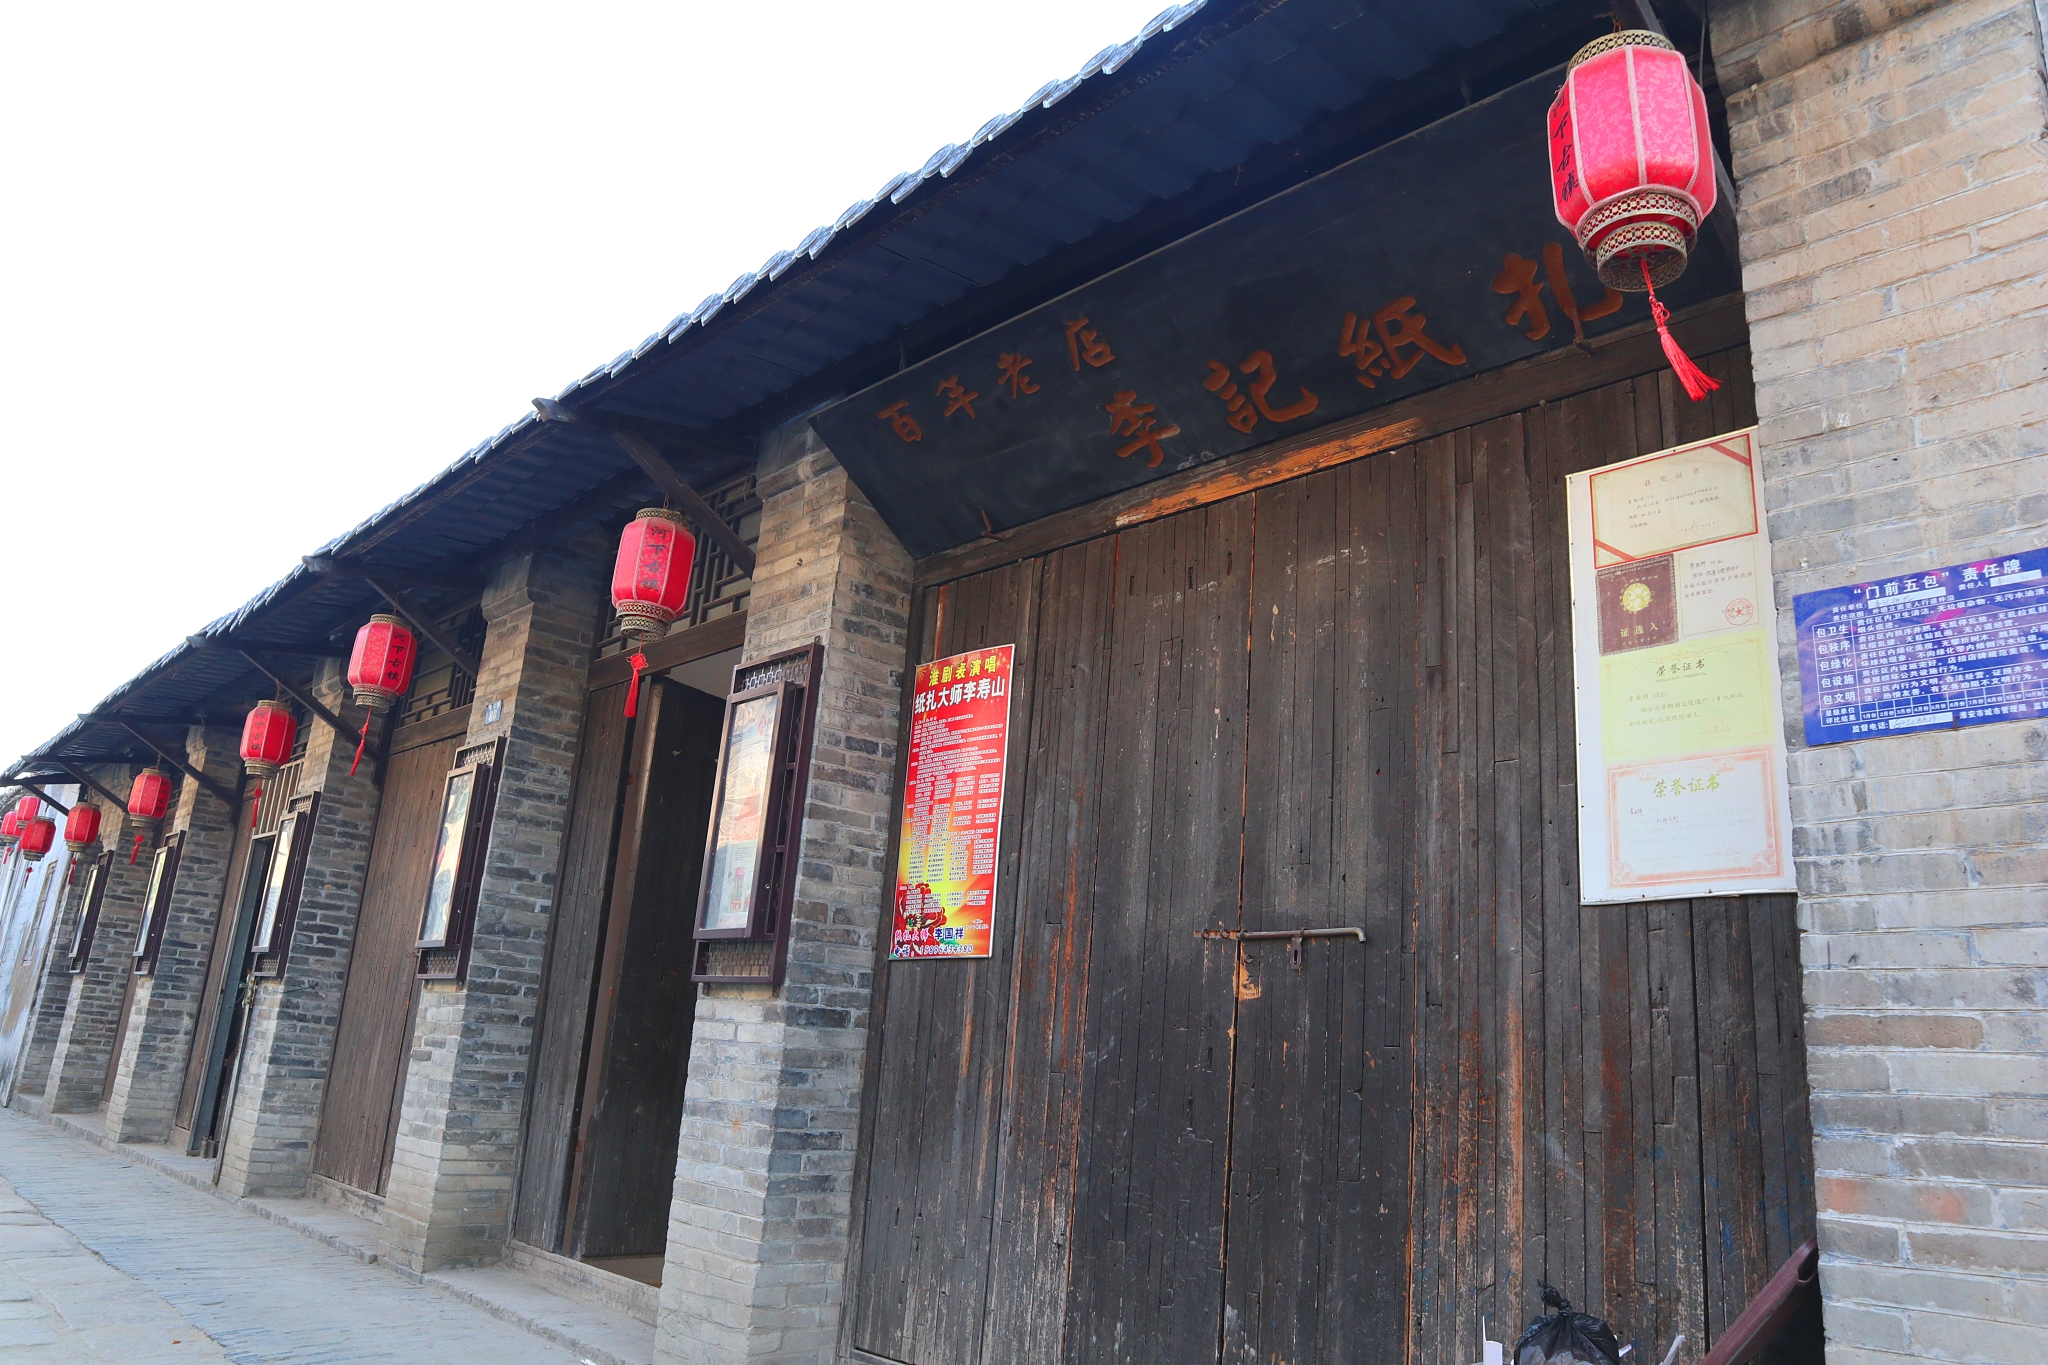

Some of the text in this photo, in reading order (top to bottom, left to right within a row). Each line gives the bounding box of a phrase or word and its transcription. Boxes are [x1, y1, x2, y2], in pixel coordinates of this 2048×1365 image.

[1104, 242, 1624, 468] 李記紙扎
[877, 316, 1115, 444] 百年老店
[641, 525, 672, 592] 河下古镇
[1962, 559, 2021, 582] 责任牌
[1816, 624, 1849, 638] 包卫生
[1818, 640, 1851, 655] 包秩序
[1656, 658, 1706, 677] 荣誉证书
[1820, 657, 1853, 671] 包绿化
[1821, 674, 1854, 688] 包设施
[914, 675, 1006, 715] 纸扎大师李寿山
[1823, 691, 1856, 705] 包文明
[1653, 773, 1720, 799] 荣誉证书
[933, 926, 965, 941] 李国祥
